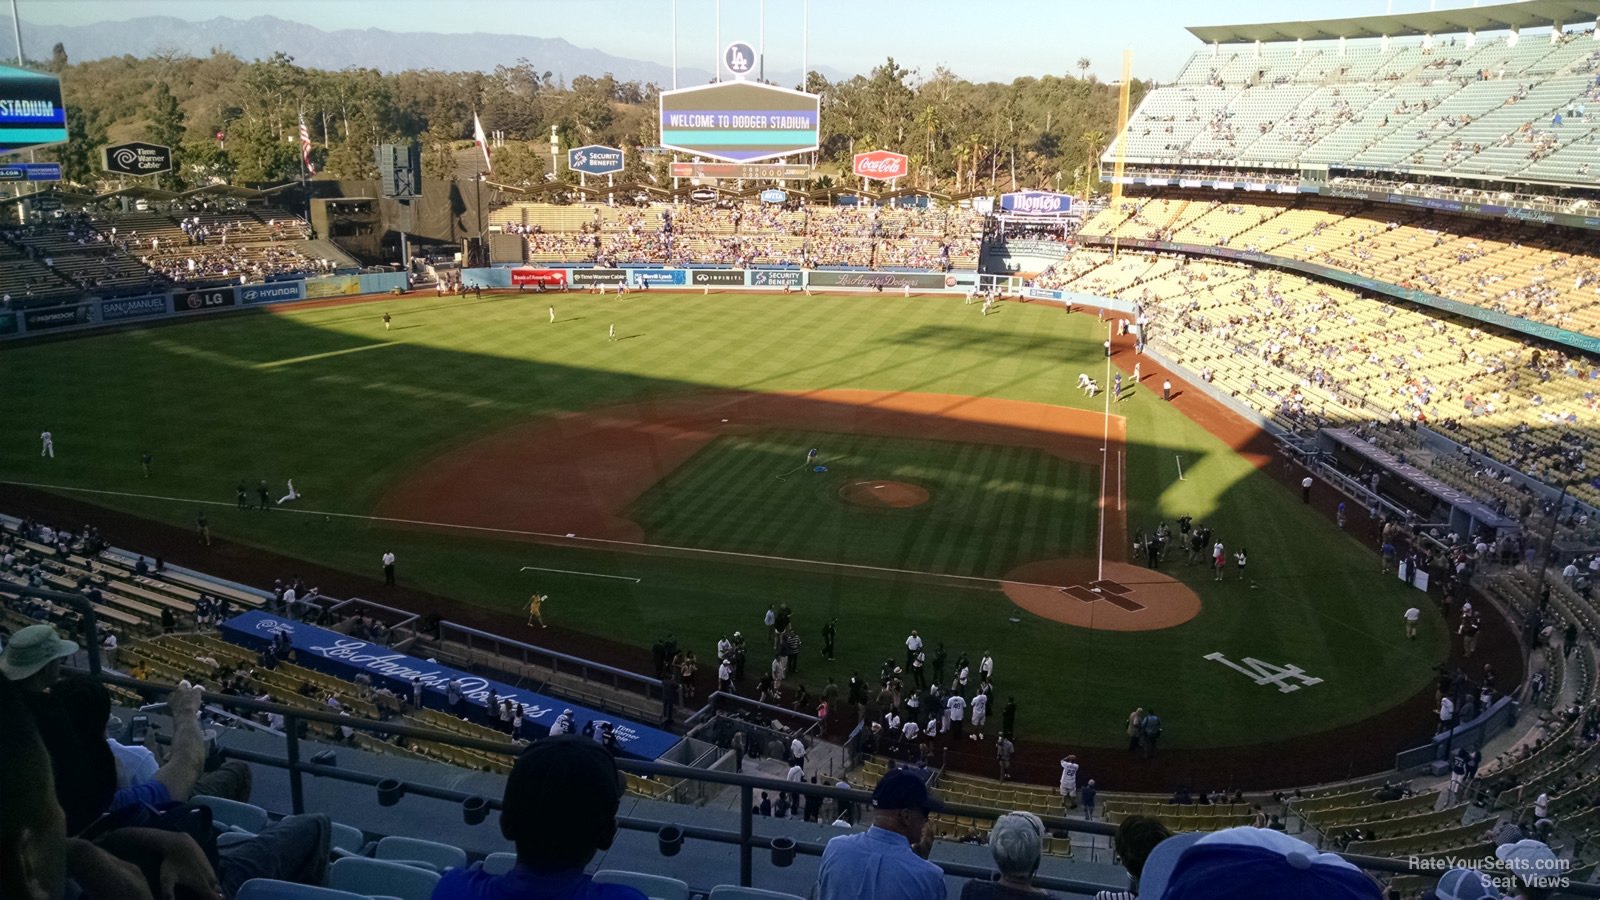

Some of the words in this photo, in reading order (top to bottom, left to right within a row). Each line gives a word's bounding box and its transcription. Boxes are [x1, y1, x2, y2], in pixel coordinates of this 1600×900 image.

[731, 46, 748, 70] LA
[0, 99, 54, 117] STADIUM
[670, 114, 714, 128] WELCOME
[718, 115, 729, 128] TO
[732, 115, 767, 129] DODGER
[770, 117, 810, 130] STADIUM
[136, 148, 156, 156] Time
[137, 155, 165, 163] Warner
[589, 152, 620, 160] SECURITY
[1013, 195, 1061, 212] Montejo
[205, 293, 223, 305] LG
[259, 287, 299, 298] HYUNDAI
[103, 303, 122, 313] SAN
[127, 298, 165, 310] MANUEL
[310, 639, 358, 660] Los
[1202, 651, 1325, 694] LA
[617, 724, 636, 734] Time
